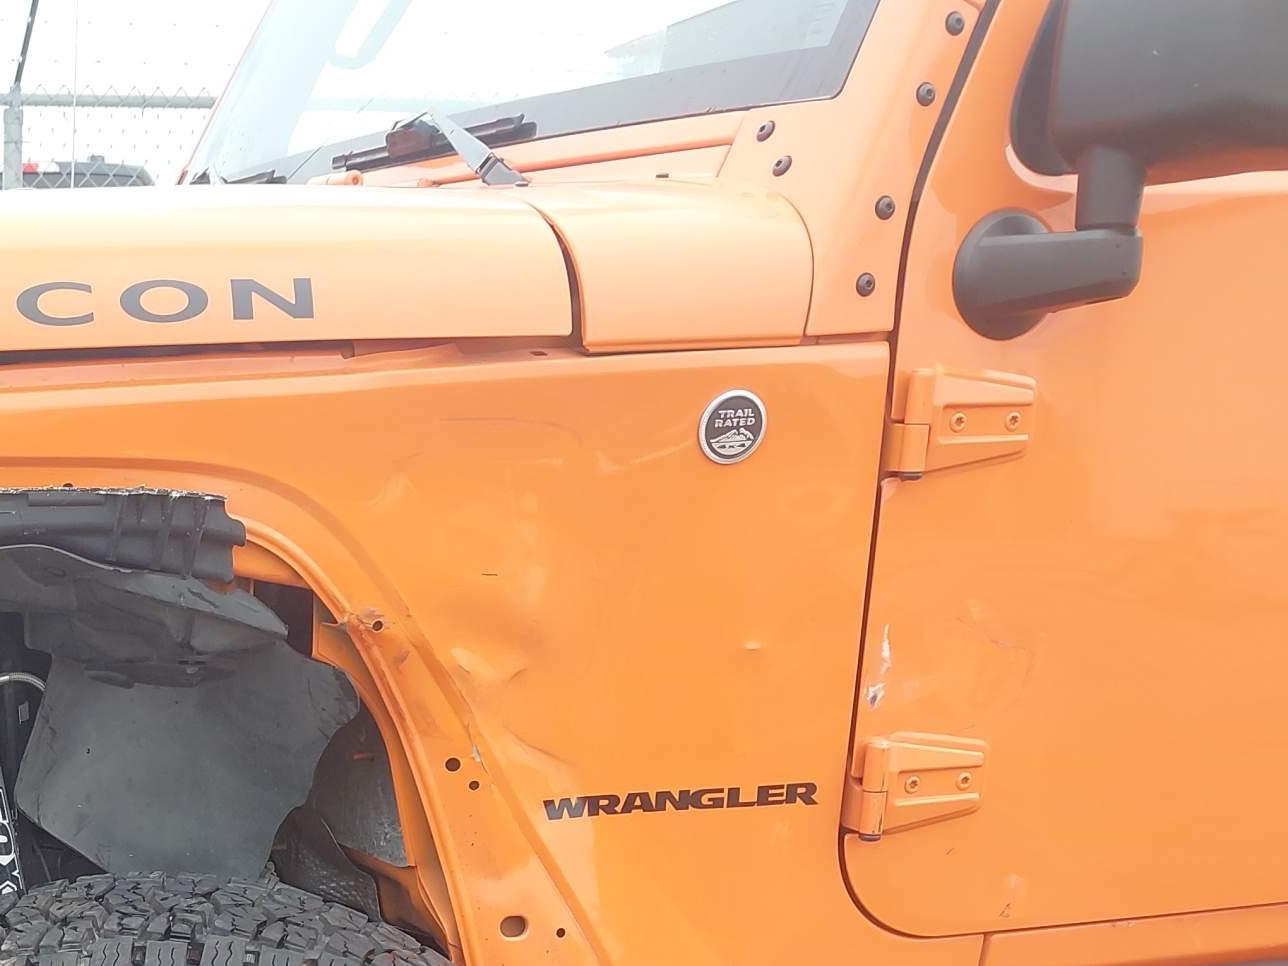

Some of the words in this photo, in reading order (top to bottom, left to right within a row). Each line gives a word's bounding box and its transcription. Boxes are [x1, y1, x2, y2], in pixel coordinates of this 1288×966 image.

[718, 408, 755, 419] TRAIL
[714, 417, 756, 428] RATED
[542, 781, 819, 821] WRANGLER
